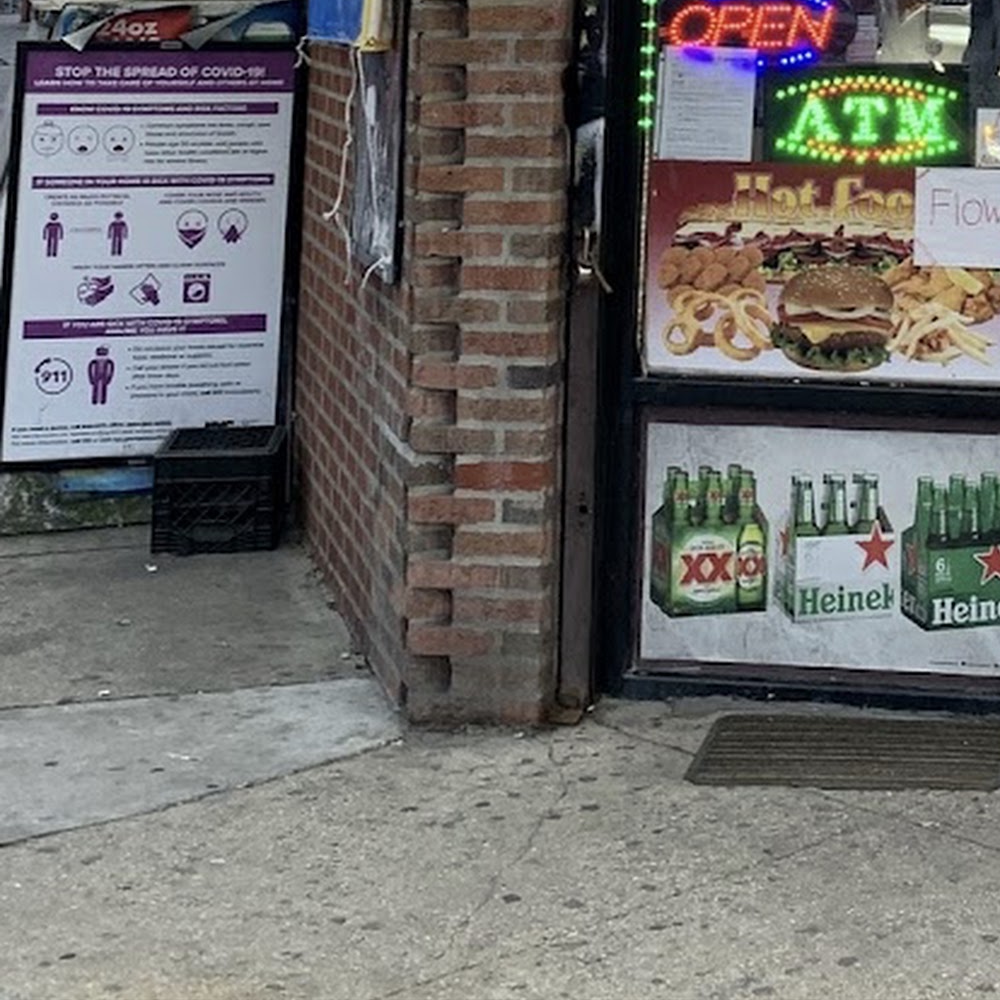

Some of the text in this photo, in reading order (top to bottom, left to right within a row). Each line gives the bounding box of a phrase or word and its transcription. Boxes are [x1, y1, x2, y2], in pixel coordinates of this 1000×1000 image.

[668, 3, 837, 49] OPEN
[55, 65, 92, 78] STOP
[95, 65, 121, 78] THE
[123, 65, 178, 78] SPREAD
[180, 65, 199, 78] OF
[790, 96, 946, 143] ATM
[730, 173, 915, 221] Hot Foo
[40, 369, 68, 384] 911
[679, 551, 735, 587] XX
